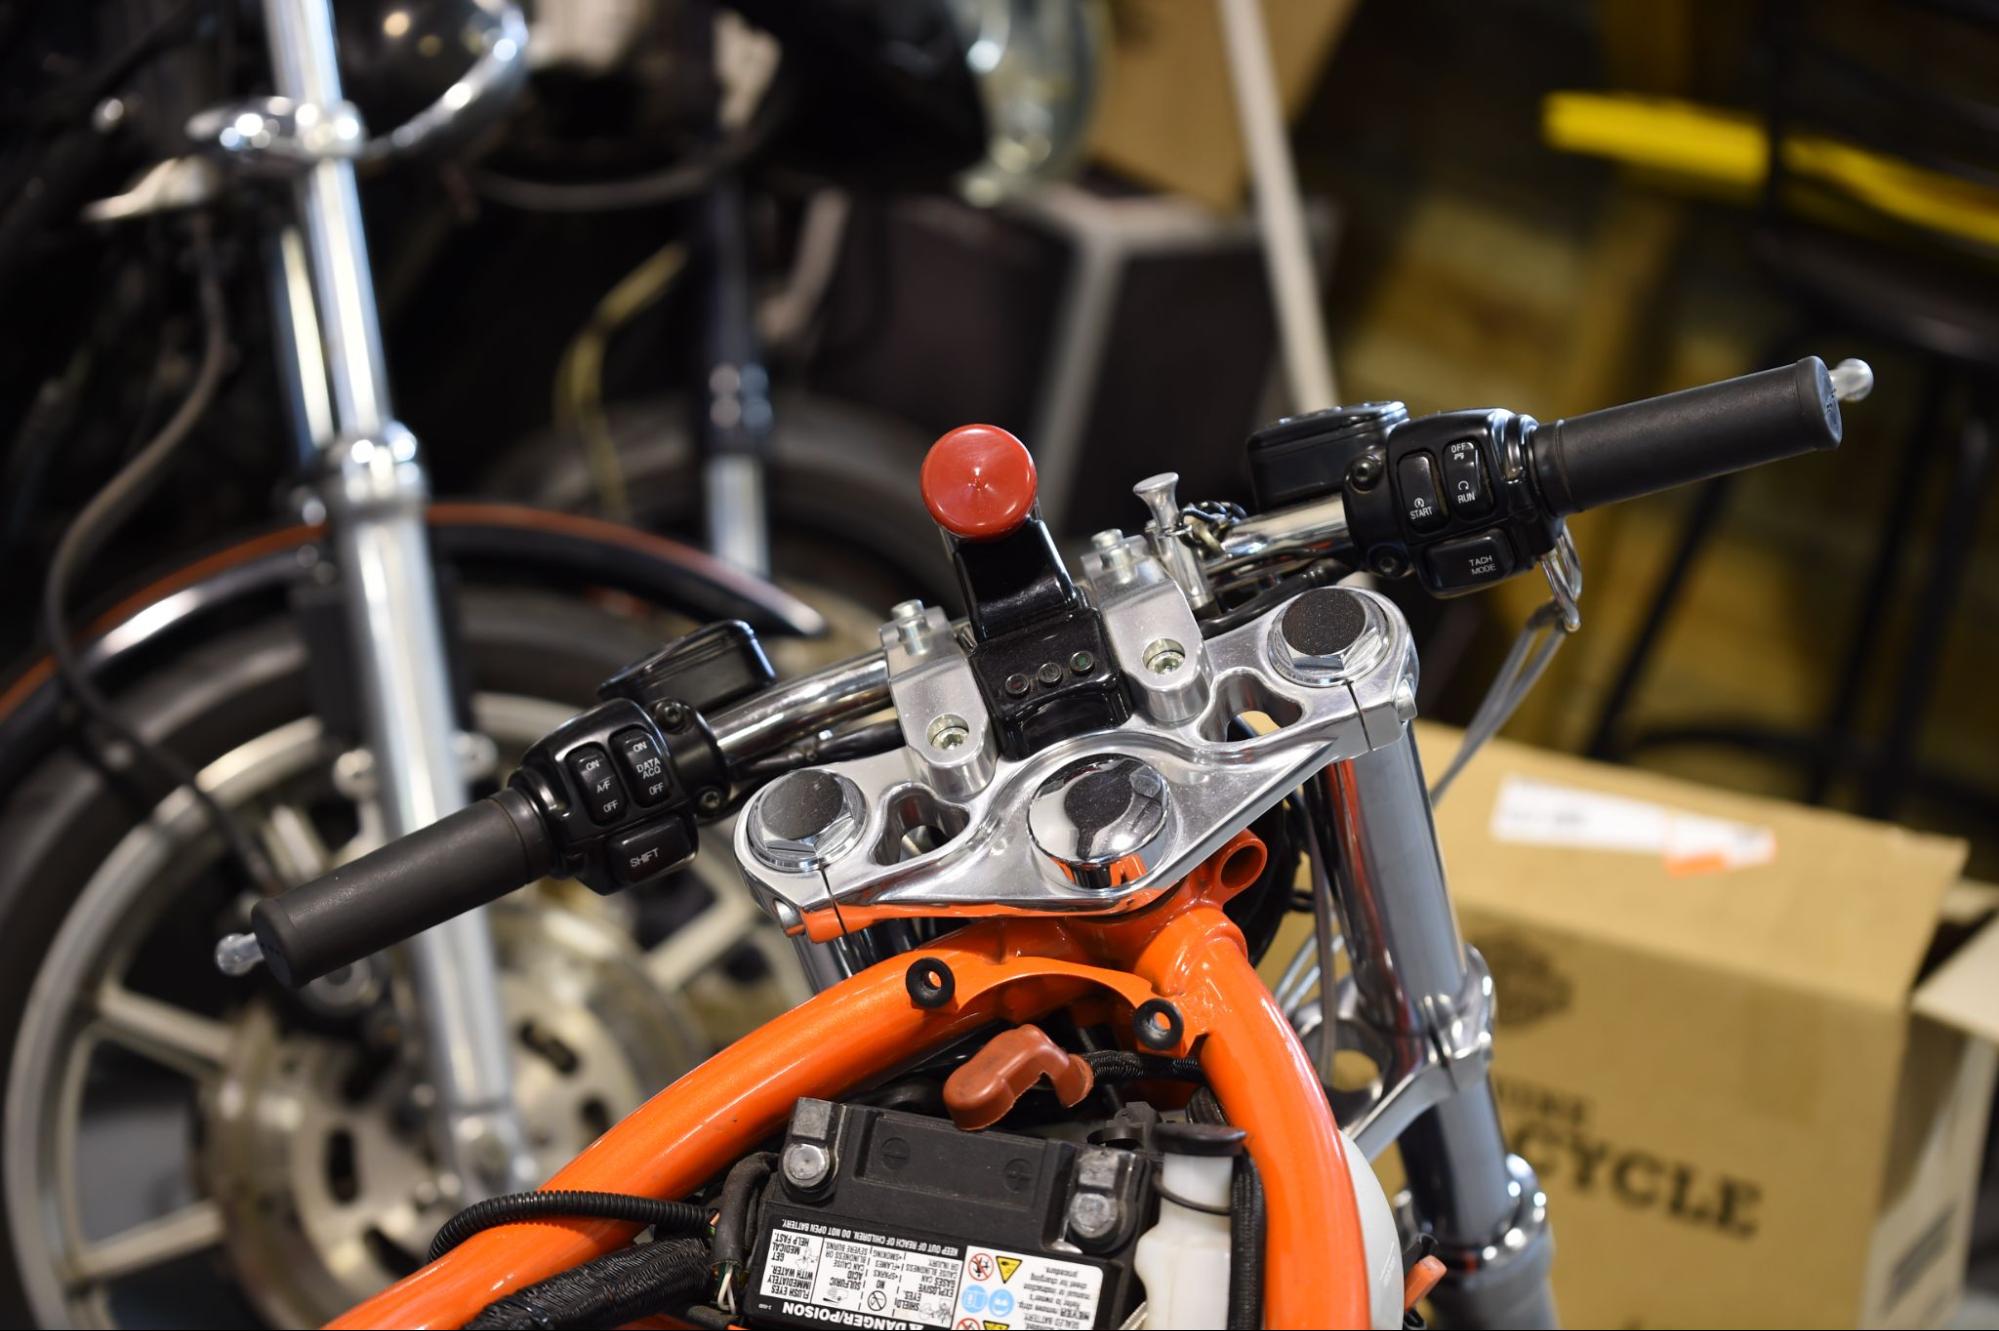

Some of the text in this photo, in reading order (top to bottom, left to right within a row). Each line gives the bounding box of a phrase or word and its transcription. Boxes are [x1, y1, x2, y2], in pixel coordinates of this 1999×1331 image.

[1451, 443, 1466, 453] OFF
[1458, 493, 1475, 503] RUN
[1410, 507, 1432, 519] START
[1469, 555, 1493, 566] TACH
[1472, 564, 1496, 575] MODE
[633, 742, 647, 752] ON
[586, 760, 600, 771] ON
[637, 758, 660, 773] DATA
[643, 766, 661, 779] ACQ
[649, 783, 664, 795] OFF
[603, 800, 618, 812] OFF
[630, 848, 658, 867] SHIFT
[774, 1233, 809, 1246] HELP FAST.
[782, 1219, 959, 1256] KEEP OUT OF REACH OF CHILDREN. DO NOT OPEN BATTERY.
[772, 1242, 800, 1255] MEDICAL
[771, 1252, 784, 1262] GET
[833, 1260, 851, 1269] CAUSE
[771, 1265, 813, 1280] WITH WATER.
[847, 1271, 863, 1280] ACID
[767, 1275, 811, 1289] IMMEDIATELY
[829, 1277, 861, 1290] SULFURIC
[876, 1280, 885, 1289] NO
[935, 1278, 956, 1288] GASES
[771, 1285, 809, 1299] FLUSH EYES
[903, 1291, 921, 1301] EYES.
[919, 1284, 954, 1297] EXPLOSIVE
[897, 1300, 919, 1311] SHIELD
[782, 1301, 907, 1330] DANGER/POISON
[1061, 1308, 1089, 1320] NEVER
